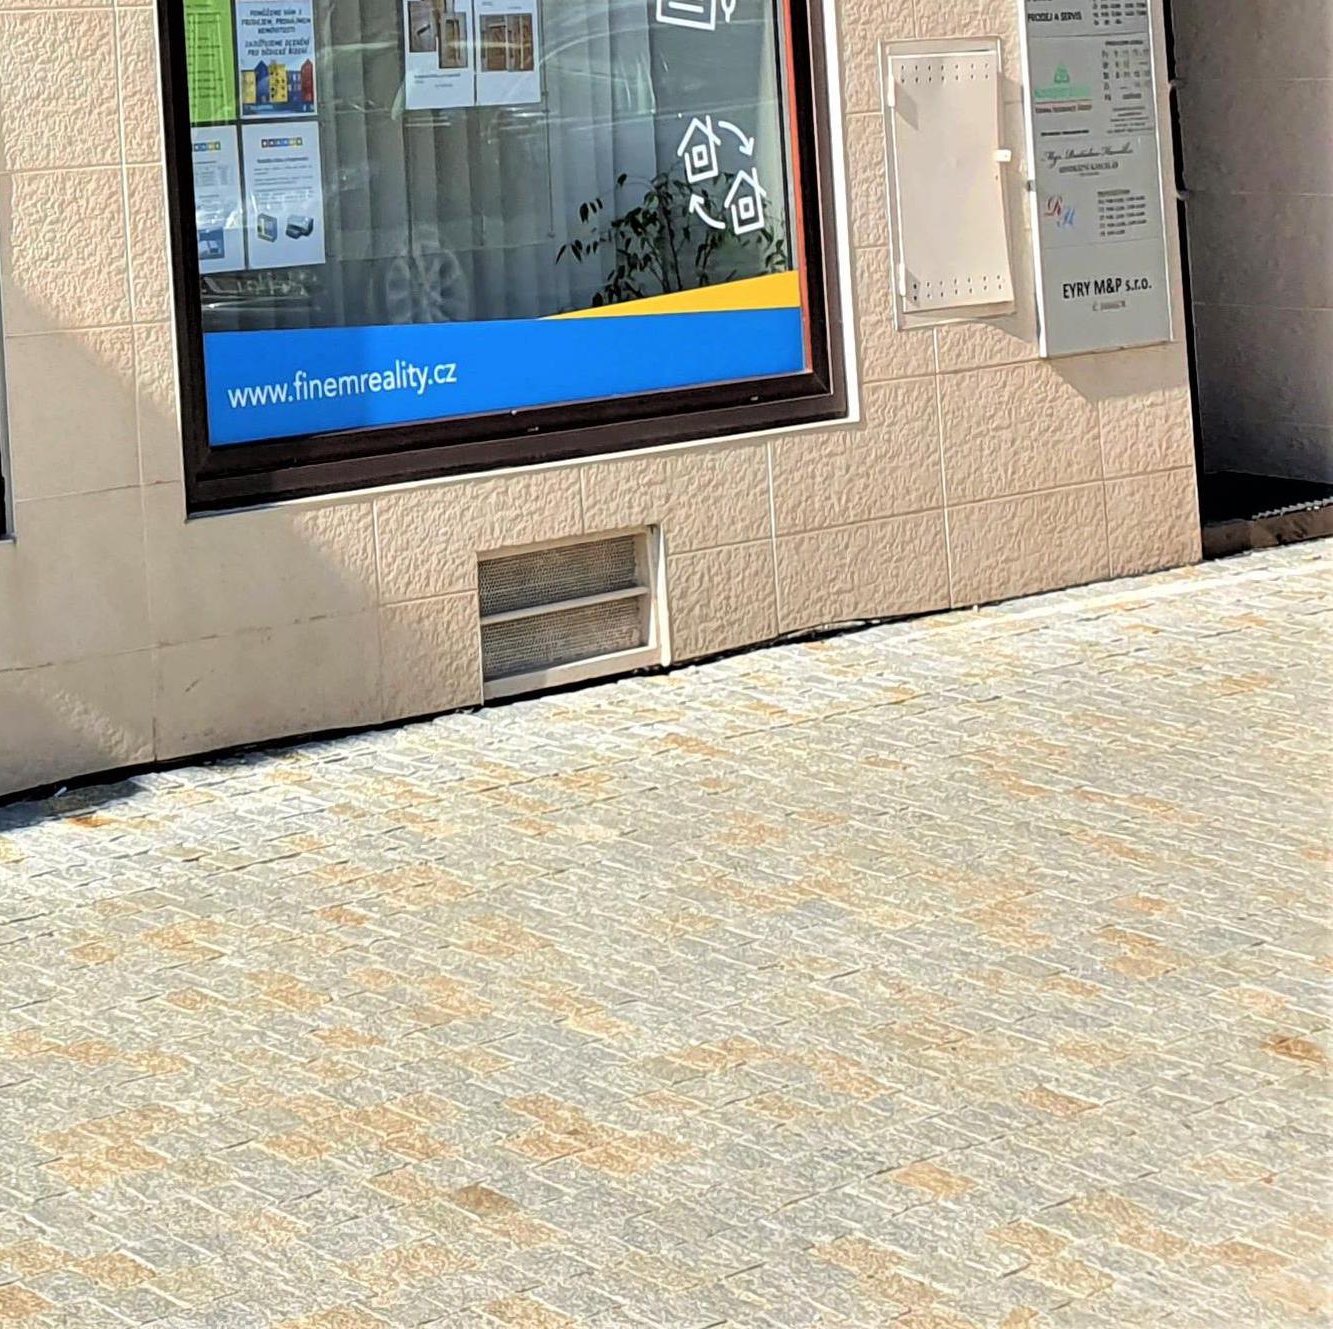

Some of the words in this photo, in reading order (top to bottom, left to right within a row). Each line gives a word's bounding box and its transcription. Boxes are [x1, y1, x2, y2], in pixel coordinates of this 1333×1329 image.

[1062, 280, 1091, 299] EYRY
[1093, 277, 1122, 295] M&P
[1125, 277, 1153, 292] s.r.o.
[227, 359, 458, 410] www.finemreality.cz
